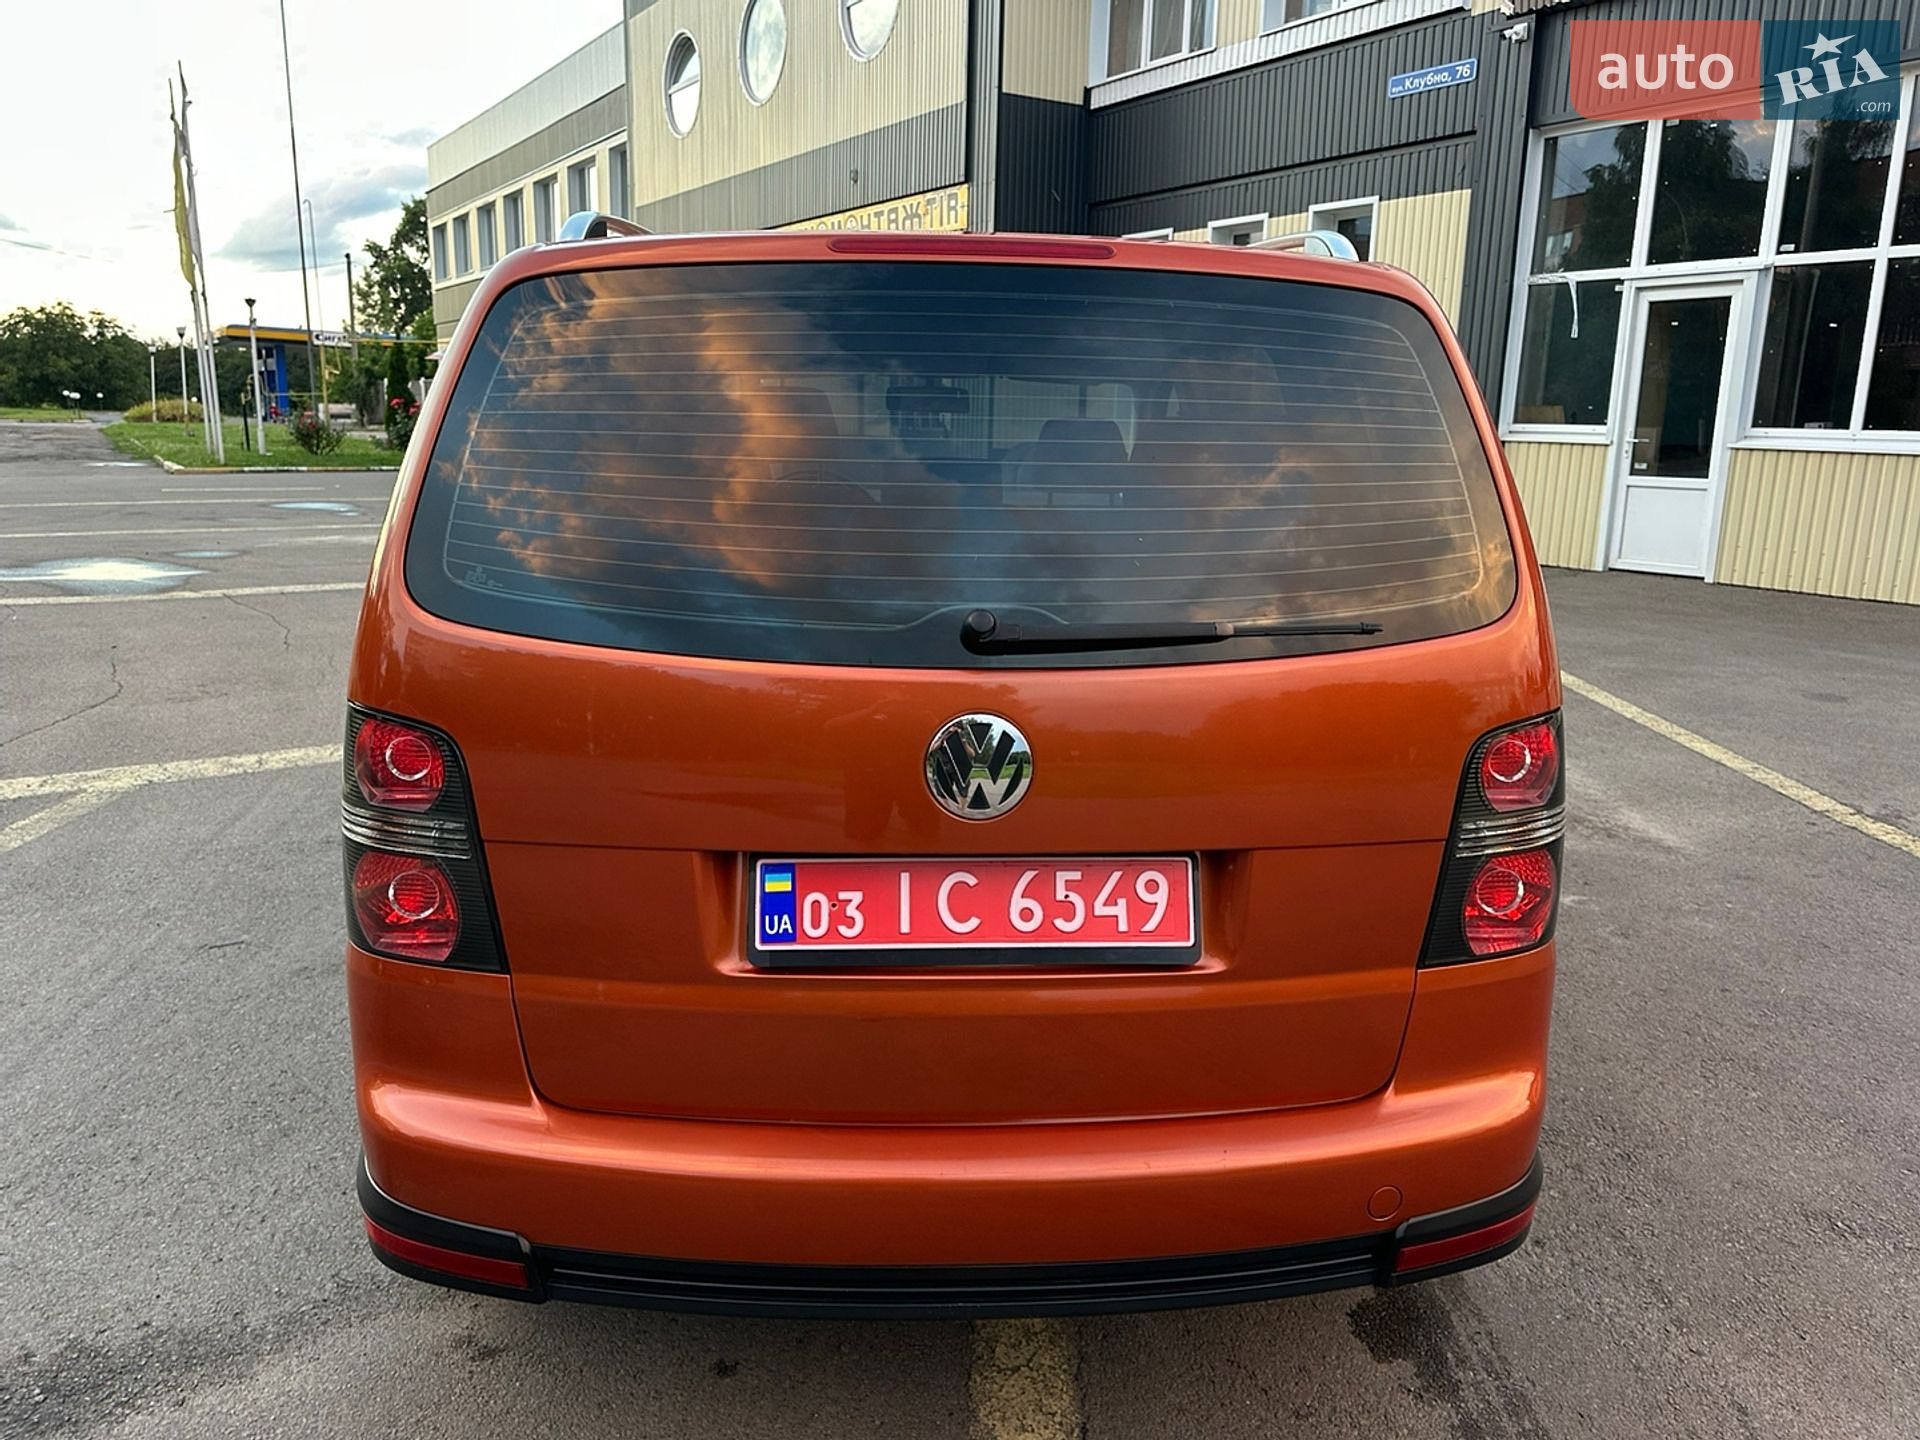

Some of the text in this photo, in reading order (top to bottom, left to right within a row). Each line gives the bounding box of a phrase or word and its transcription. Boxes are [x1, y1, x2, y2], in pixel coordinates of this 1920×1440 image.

[1404, 71, 1452, 90] Клубна,
[1455, 64, 1471, 79] 76
[802, 890, 865, 938] 03
[1008, 869, 1170, 934] 6549
[764, 914, 793, 934] UA
